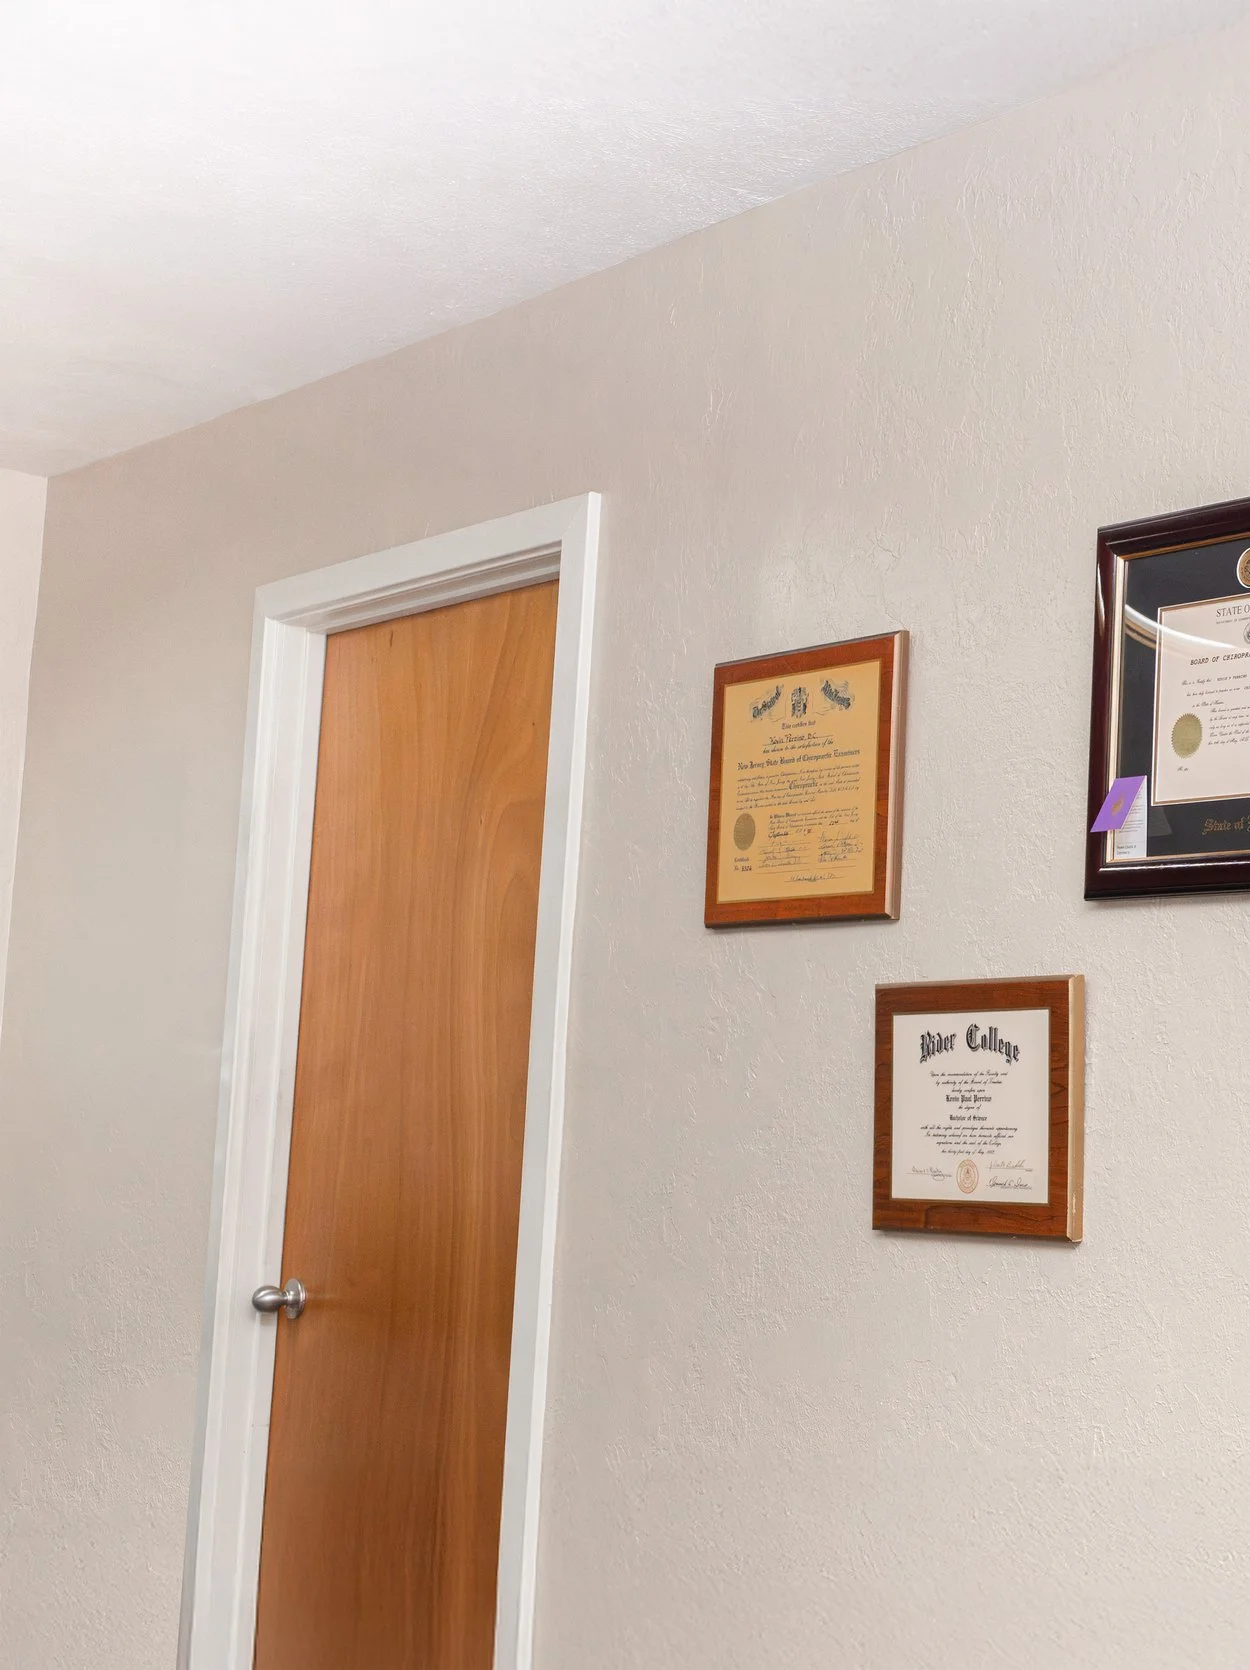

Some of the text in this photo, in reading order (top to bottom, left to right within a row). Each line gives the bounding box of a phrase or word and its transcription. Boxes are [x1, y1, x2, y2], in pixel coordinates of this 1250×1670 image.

[1216, 606, 1242, 618] STATE
[1190, 657, 1209, 666] BOARD
[1202, 818, 1231, 835] State
[1234, 816, 1245, 830] of
[920, 1023, 1020, 1065] Rider College
